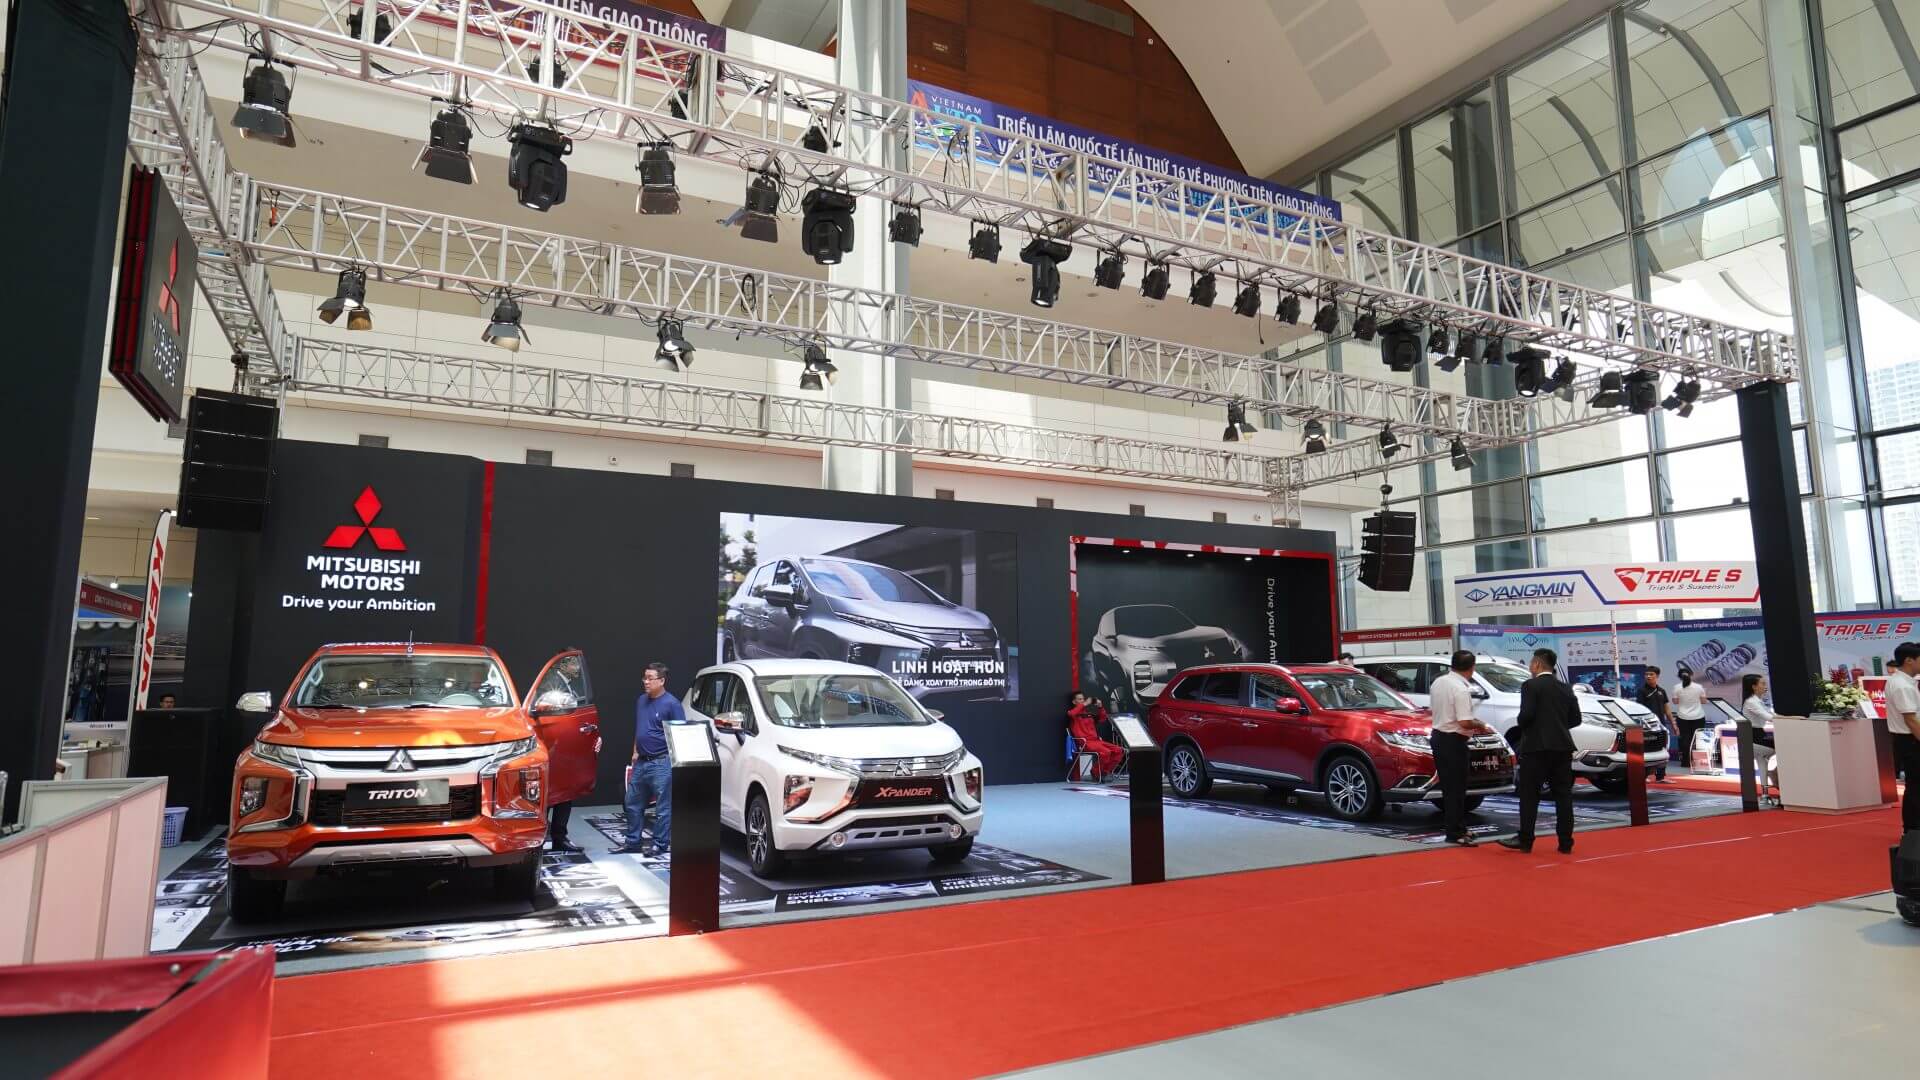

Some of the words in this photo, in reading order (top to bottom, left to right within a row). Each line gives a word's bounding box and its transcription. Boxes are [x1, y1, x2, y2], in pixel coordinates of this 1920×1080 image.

[598, 6, 643, 31] GIAO
[931, 95, 982, 115] VIETNAM
[997, 114, 1036, 139] TRIỂN
[1068, 134, 1103, 156] QUỐC
[1172, 164, 1186, 179] 16
[1274, 193, 1299, 211] GIAO
[306, 555, 421, 575] MITSUBISHI
[321, 574, 405, 592] MOTORS
[1645, 569, 1720, 583] TRIPLE
[1725, 569, 1742, 582] S
[1267, 578, 1275, 608] Drive
[1489, 582, 1576, 601] YANGMIN
[1648, 584, 1674, 592] Triple
[1678, 583, 1684, 591] S
[282, 595, 324, 608] Drive
[328, 600, 363, 611] your
[366, 598, 436, 611] Ambition
[1266, 611, 1275, 638] your
[1825, 623, 1890, 636] TRIPLE
[1895, 622, 1912, 634] S
[891, 660, 927, 674] LINH
[932, 660, 970, 677] HOẠT
[925, 679, 943, 687] XOAY
[960, 679, 982, 687] TRONG
[368, 788, 428, 800] TRITON
[874, 787, 933, 798] XPANDER
[786, 896, 846, 905] SHIELD
